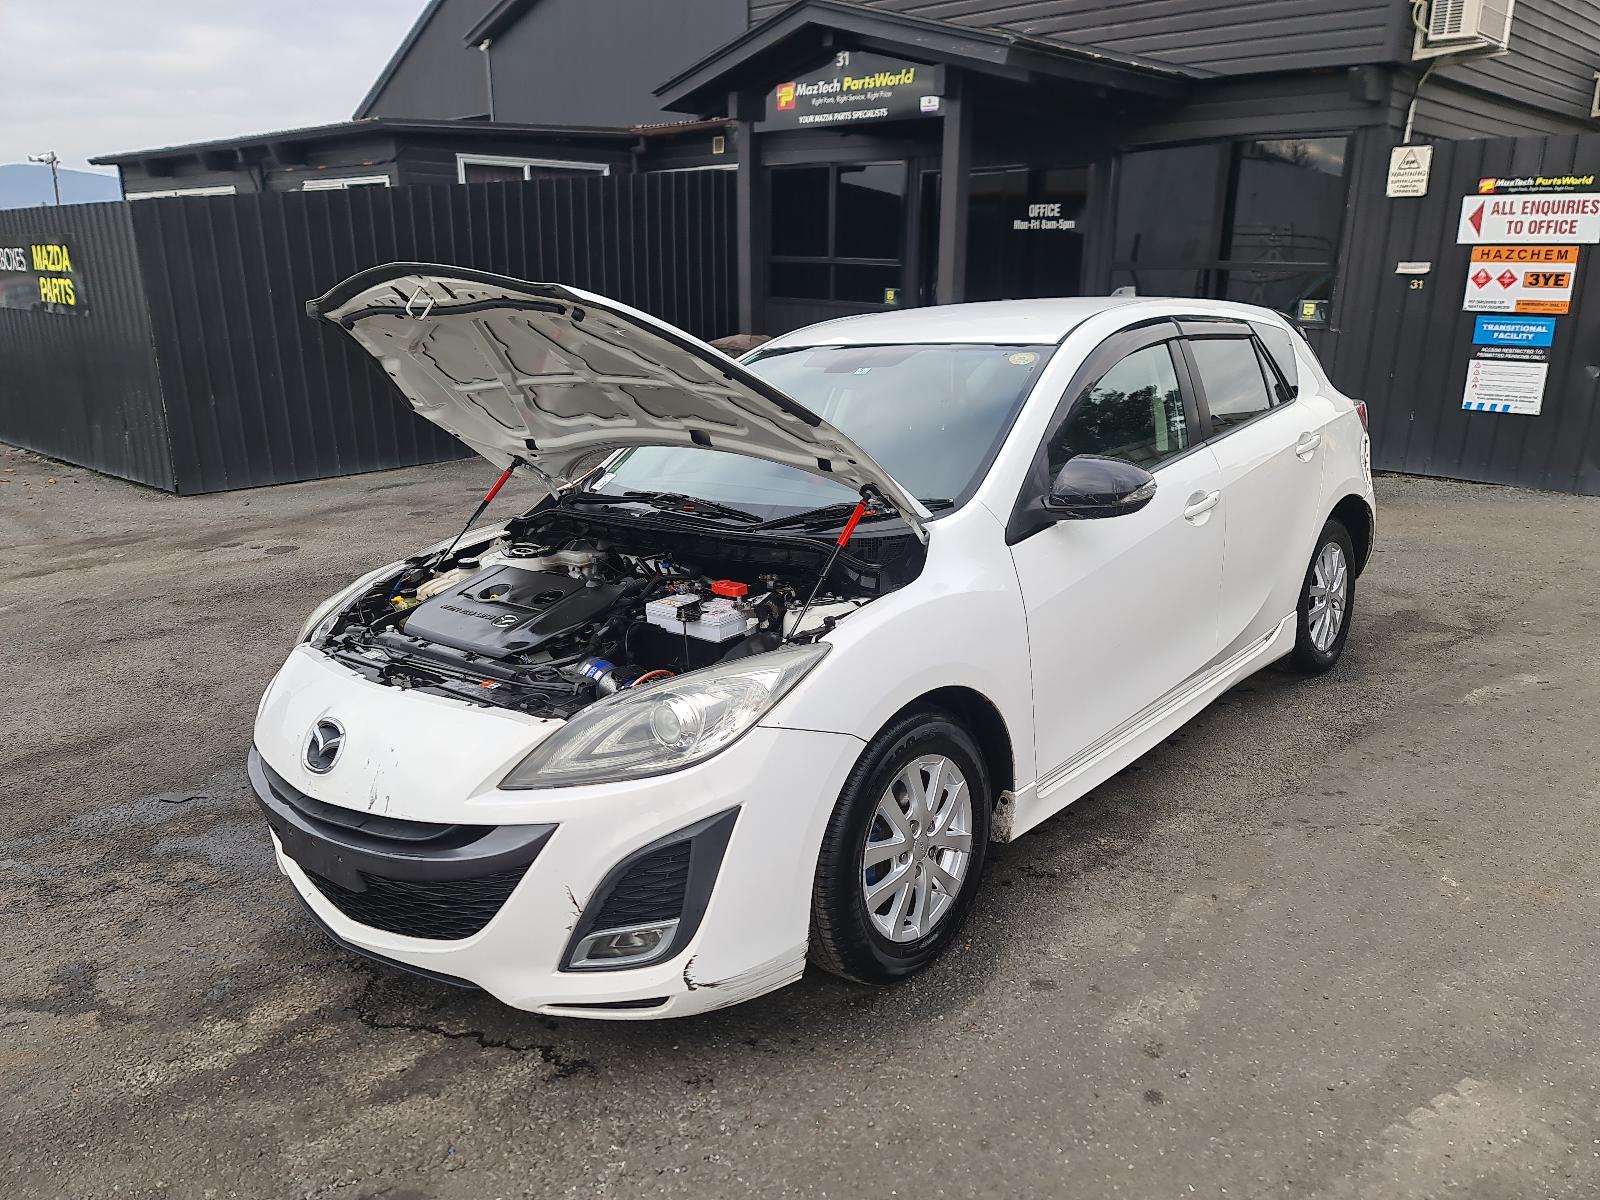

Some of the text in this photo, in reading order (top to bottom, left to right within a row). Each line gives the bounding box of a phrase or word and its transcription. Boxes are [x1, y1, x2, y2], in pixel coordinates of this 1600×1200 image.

[836, 51, 849, 67] 31
[796, 68, 915, 97] MazTech PartsWorld
[814, 112, 833, 122] MAZDA
[834, 111, 851, 121] PARTS
[852, 108, 889, 119] SPECIALISTS
[1496, 175, 1594, 187] MazTech PartsWorld
[1028, 203, 1062, 217] OFFICE
[1490, 199, 1600, 216] ALL ENQUIRIES
[1013, 218, 1076, 231] Mon-Fri 8am-5pm
[1506, 219, 1579, 235] TO OFFICE
[31, 244, 73, 273] MAZDA
[1480, 248, 1570, 261] HAZCHEM
[1410, 279, 1424, 290] 31
[1528, 272, 1566, 287] 3YE
[39, 276, 76, 306] PARTS
[1482, 324, 1548, 333] TRANSITIONAL
[1493, 332, 1535, 340] FACILITY
